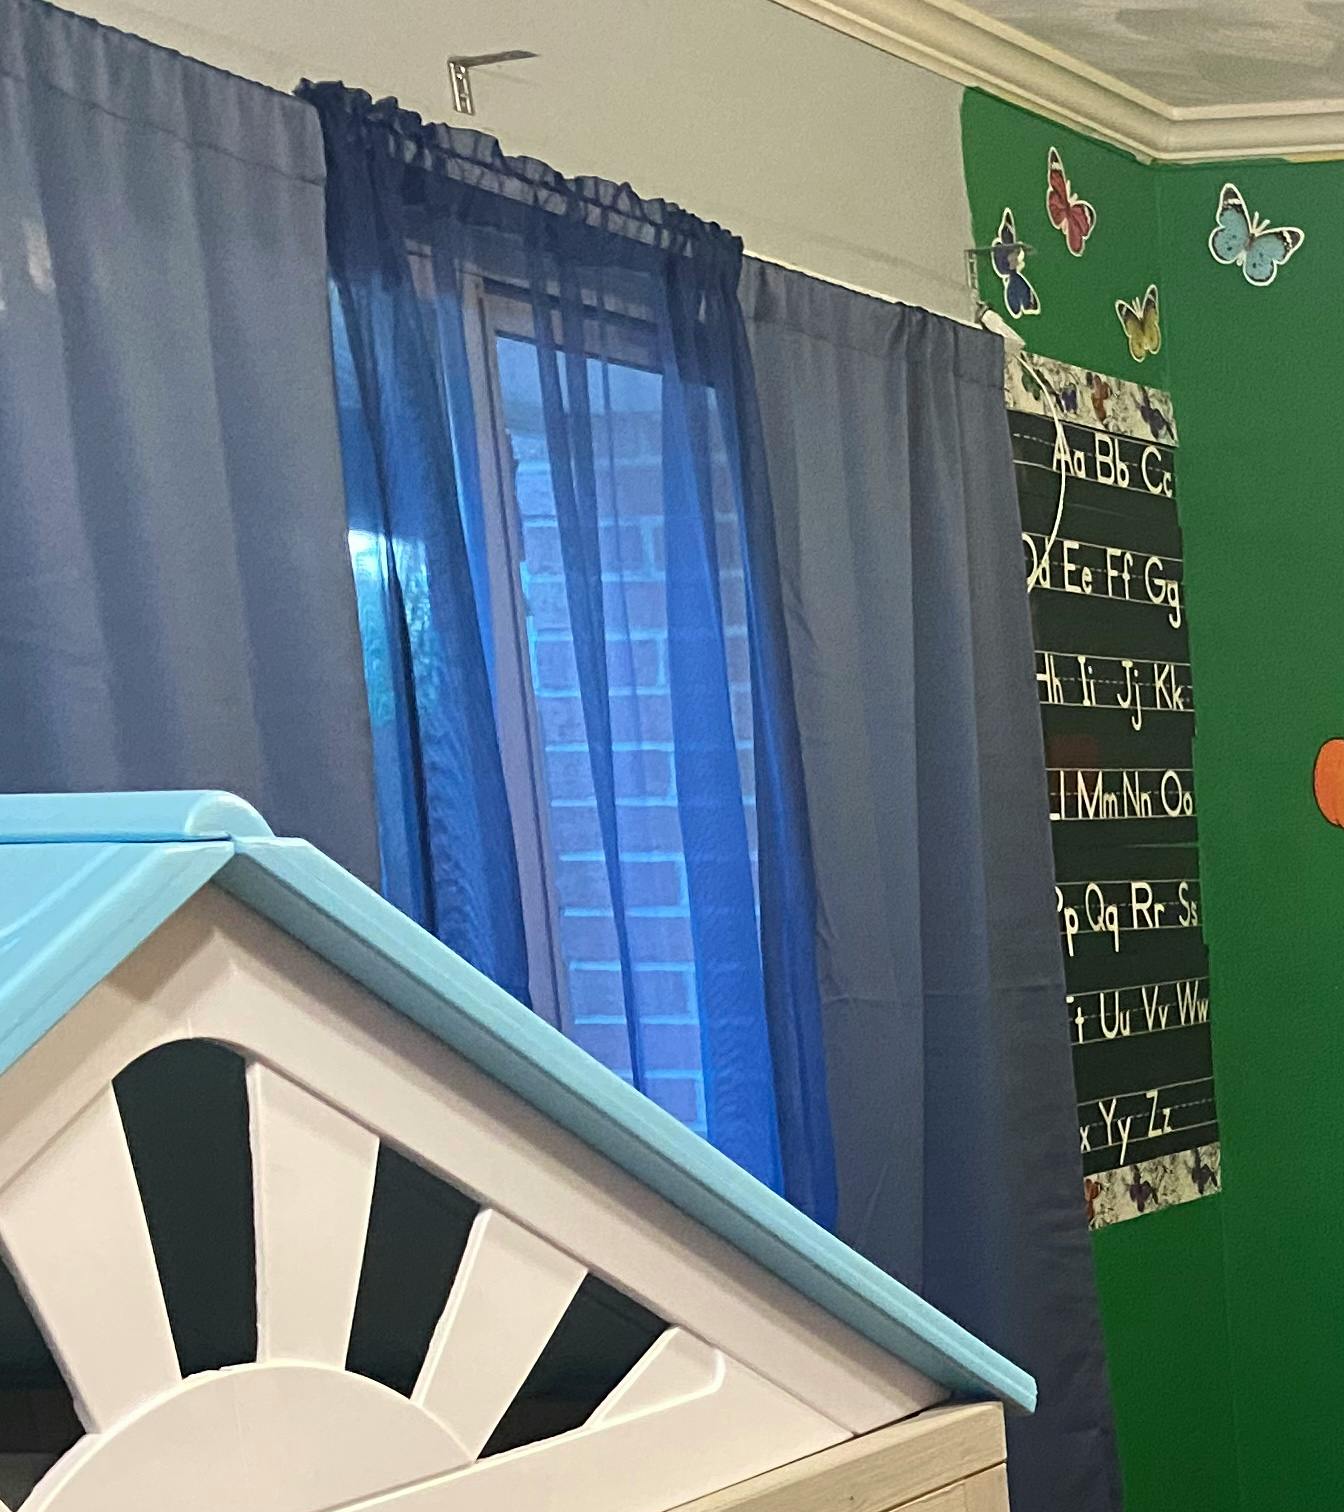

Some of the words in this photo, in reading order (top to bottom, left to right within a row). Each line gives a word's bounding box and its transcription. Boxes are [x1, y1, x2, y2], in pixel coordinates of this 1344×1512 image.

[1053, 424, 1086, 479] Aa
[1094, 431, 1129, 488] Bb
[1141, 445, 1173, 498] Cc
[1063, 541, 1093, 594] Ee
[1107, 548, 1133, 600] Ff
[1145, 556, 1181, 628] Gg
[1077, 655, 1096, 706] Ii
[1116, 660, 1142, 731] Jj
[1154, 663, 1184, 711] Kk
[1077, 770, 1119, 820] Mm
[1122, 770, 1152, 818] Nn
[1161, 769, 1193, 817] Oo
[1085, 882, 1120, 953] Qq
[1130, 881, 1165, 929] Rr
[1178, 881, 1198, 927] Ss
[1099, 990, 1130, 1039] Uu
[1141, 984, 1169, 1033] Vv
[1176, 979, 1209, 1026] Ww
[1098, 1098, 1131, 1166] Yy
[1146, 1089, 1172, 1137] Zz
